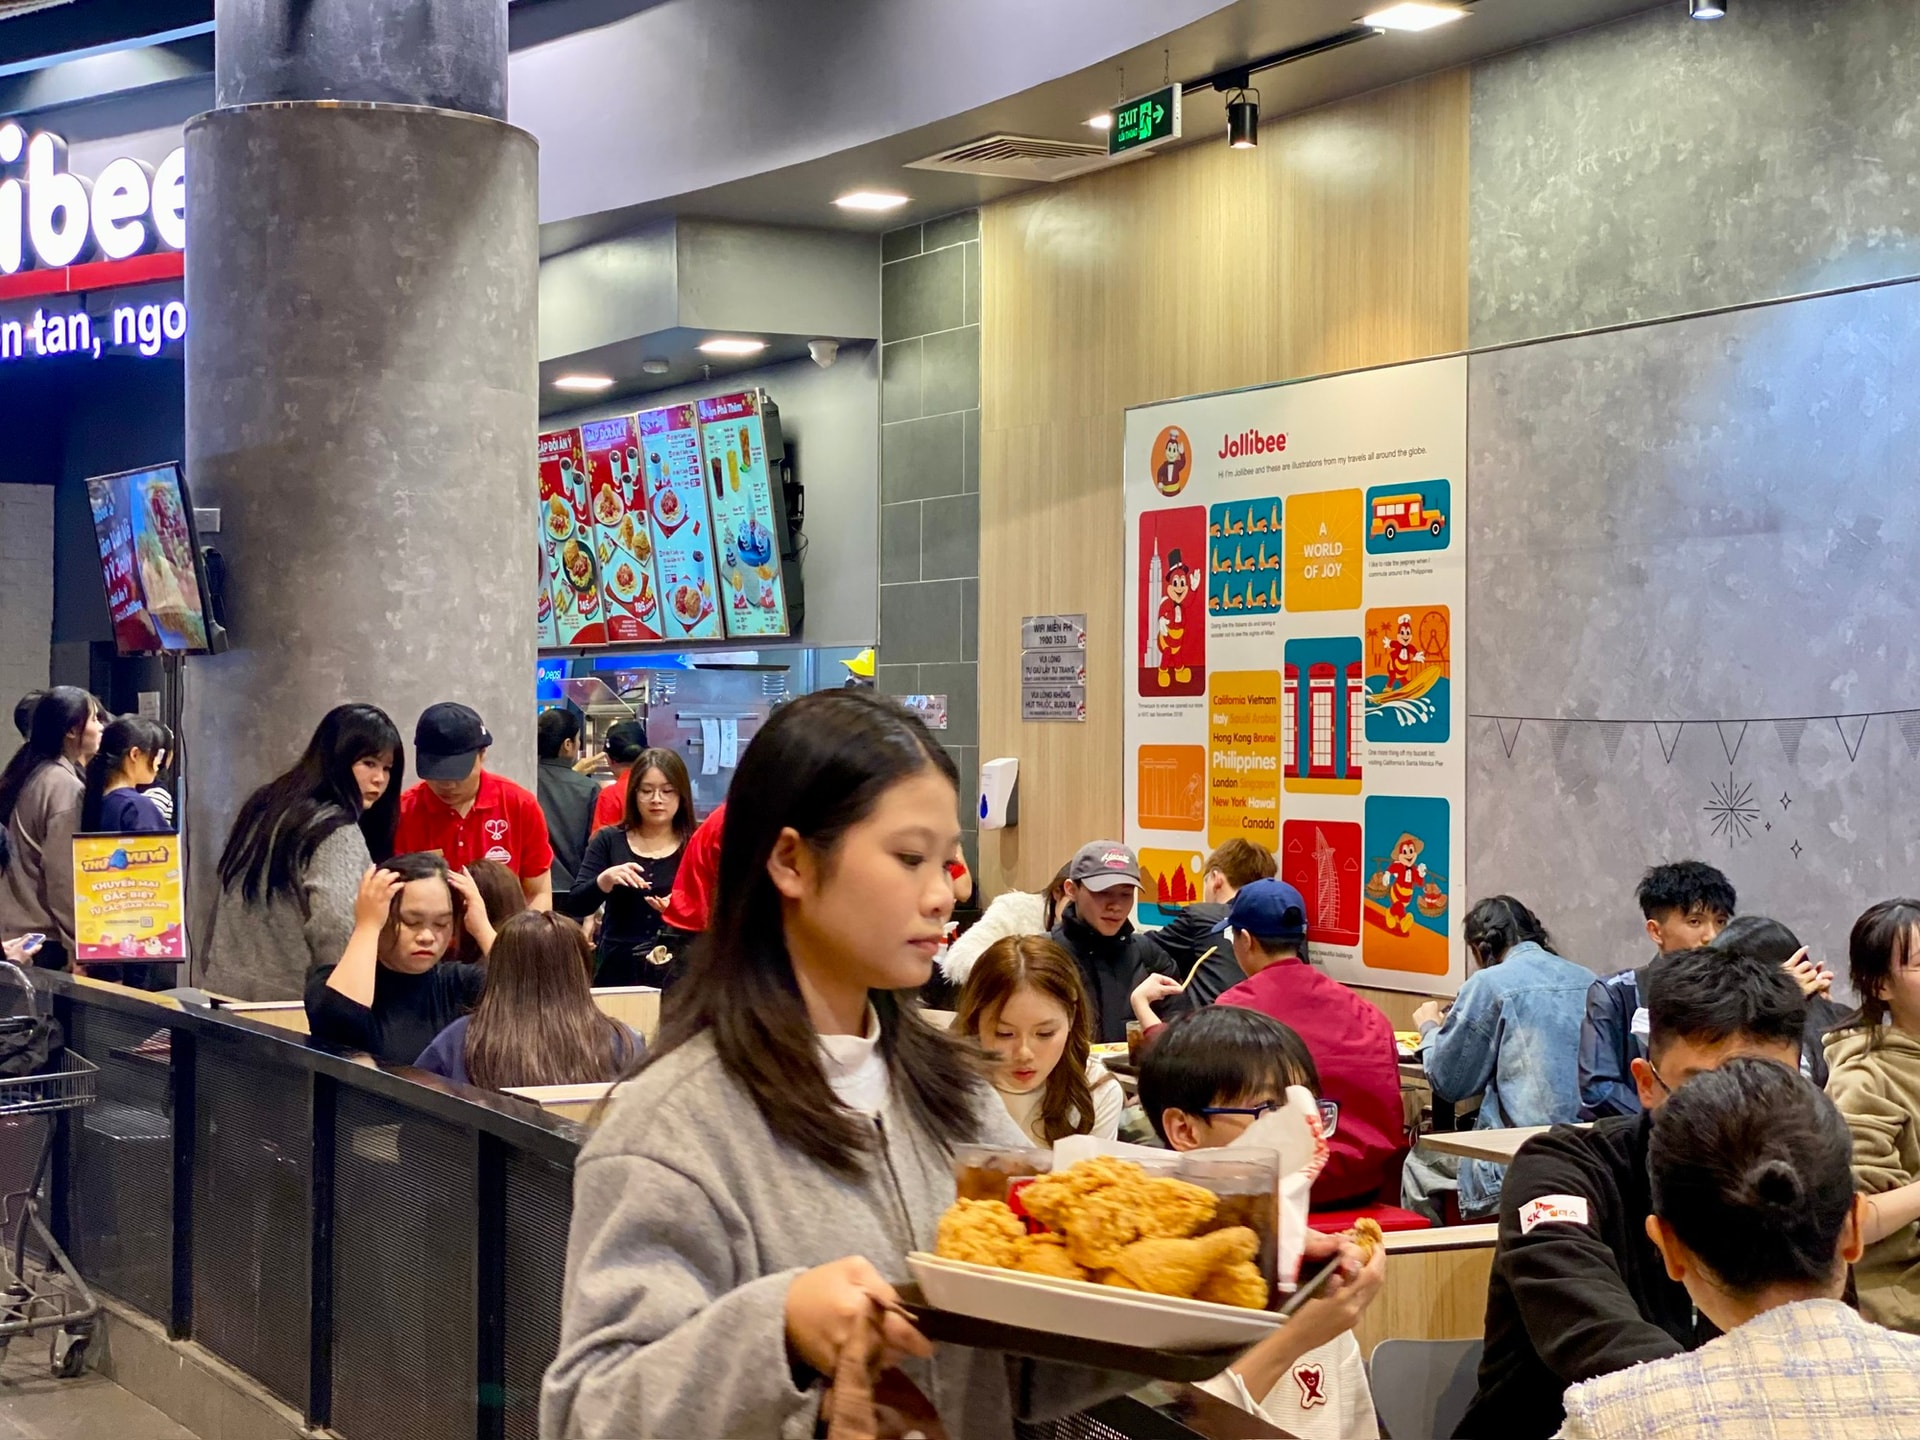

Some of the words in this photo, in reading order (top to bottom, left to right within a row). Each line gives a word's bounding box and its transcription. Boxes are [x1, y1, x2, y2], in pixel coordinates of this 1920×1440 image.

[1118, 108, 1138, 129] EXIT
[33, 308, 101, 359] tan,
[1218, 429, 1287, 459] Jollibee
[1218, 470, 1224, 479] Hi
[1225, 469, 1233, 478] I'm
[1234, 467, 1254, 477] Jollibee
[1255, 465, 1265, 475] and
[1266, 463, 1281, 473] these
[1282, 463, 1291, 471] are
[1292, 459, 1322, 470] illustrations
[1324, 457, 1336, 466] from
[1337, 457, 1346, 466] my
[1347, 453, 1366, 463] travels
[1376, 450, 1396, 460] around
[1397, 448, 1407, 458] the
[1408, 446, 1427, 458] globe.
[1319, 521, 1327, 536] A
[1304, 542, 1343, 557] WORLD
[1304, 565, 1319, 579] OF
[1321, 563, 1342, 578] JOY
[1054, 635, 1067, 644] 1533
[545, 668, 562, 681] pepsi
[1213, 695, 1246, 705] California
[1247, 695, 1276, 705] Vietnam
[1213, 714, 1229, 726] Italy
[1230, 714, 1251, 724] Saudi
[1251, 714, 1276, 724] Arabia
[1213, 733, 1232, 745] Hong
[1233, 733, 1252, 745] Kong
[1253, 733, 1276, 743] Brunei
[1213, 751, 1276, 773] Philippines
[1213, 778, 1238, 788] London
[1240, 778, 1276, 792] Singapore
[1213, 796, 1229, 807] New
[1231, 797, 1246, 808] York
[1248, 798, 1276, 809] Hawaii
[1213, 815, 1240, 827] Madrid
[1241, 816, 1275, 829] Canada
[127, 851, 148, 863] VUI
[1527, 1211, 1541, 1226] SK
